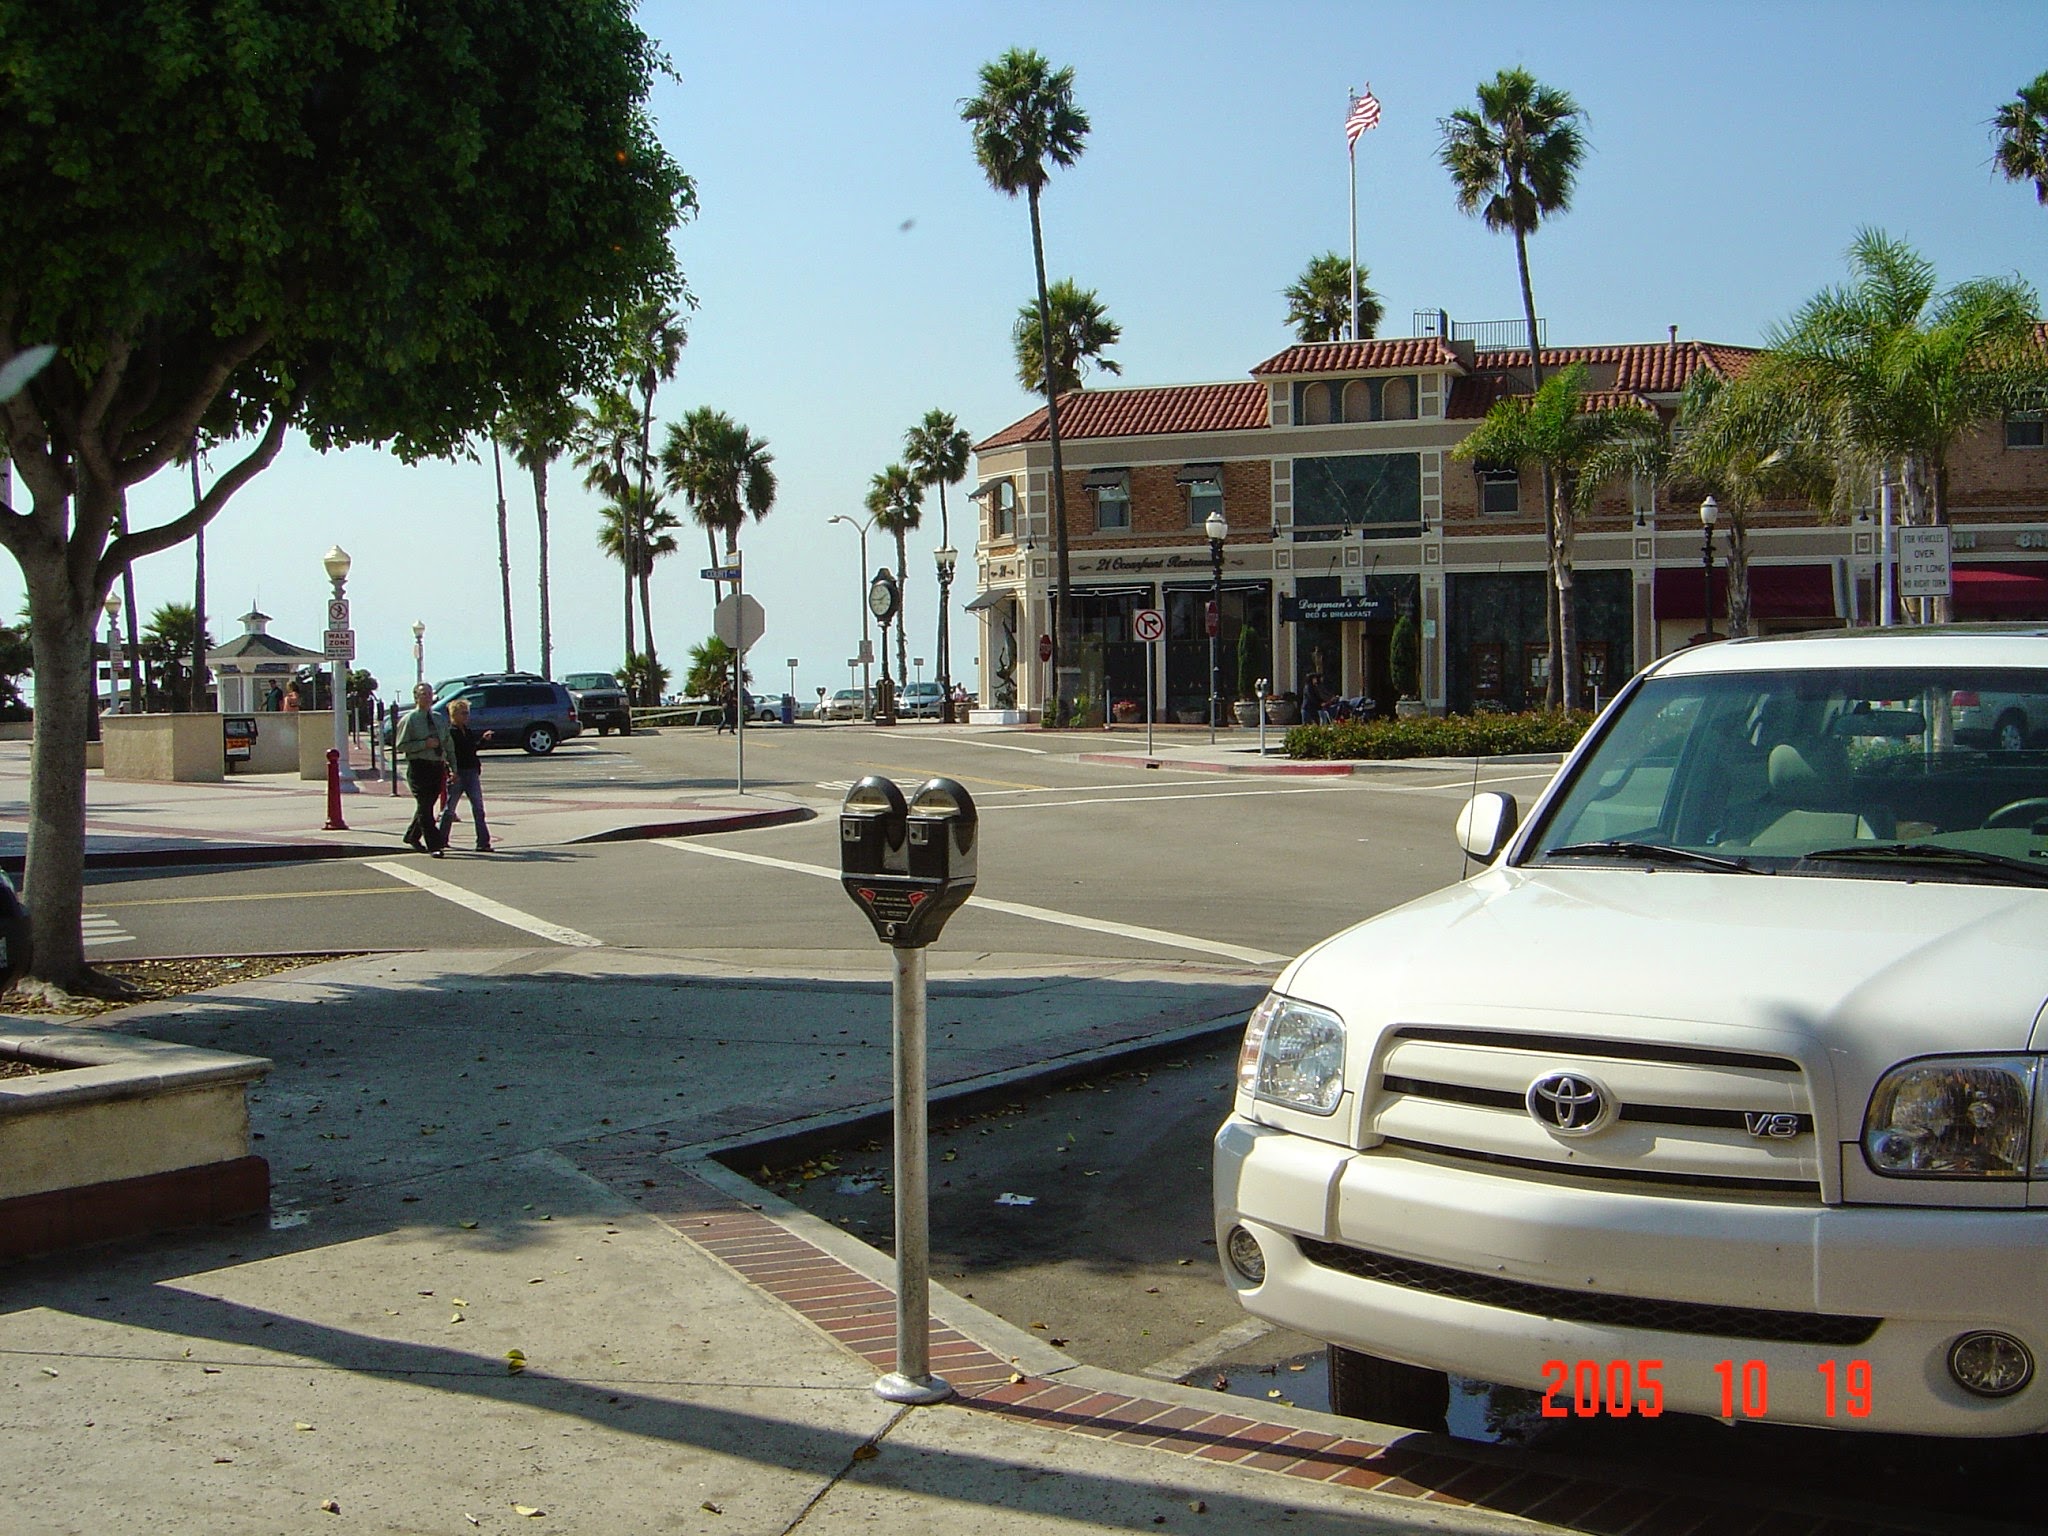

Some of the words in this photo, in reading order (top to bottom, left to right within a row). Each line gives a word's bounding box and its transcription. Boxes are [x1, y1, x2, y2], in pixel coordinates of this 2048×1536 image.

[1904, 534, 1915, 543] FOR
[1917, 534, 1944, 543] VEHICLES
[1914, 550, 1935, 558] OVER
[1096, 558, 1110, 571] 21
[1914, 565, 1922, 573] FT
[1926, 565, 1945, 573] LONG
[1904, 580, 1911, 588] NO
[1914, 580, 1929, 588] RIGHT
[1932, 580, 1946, 588] TURN
[1298, 599, 1352, 611] Doryman's
[1357, 598, 1378, 607] Inn
[1745, 1112, 1797, 1138] V8
